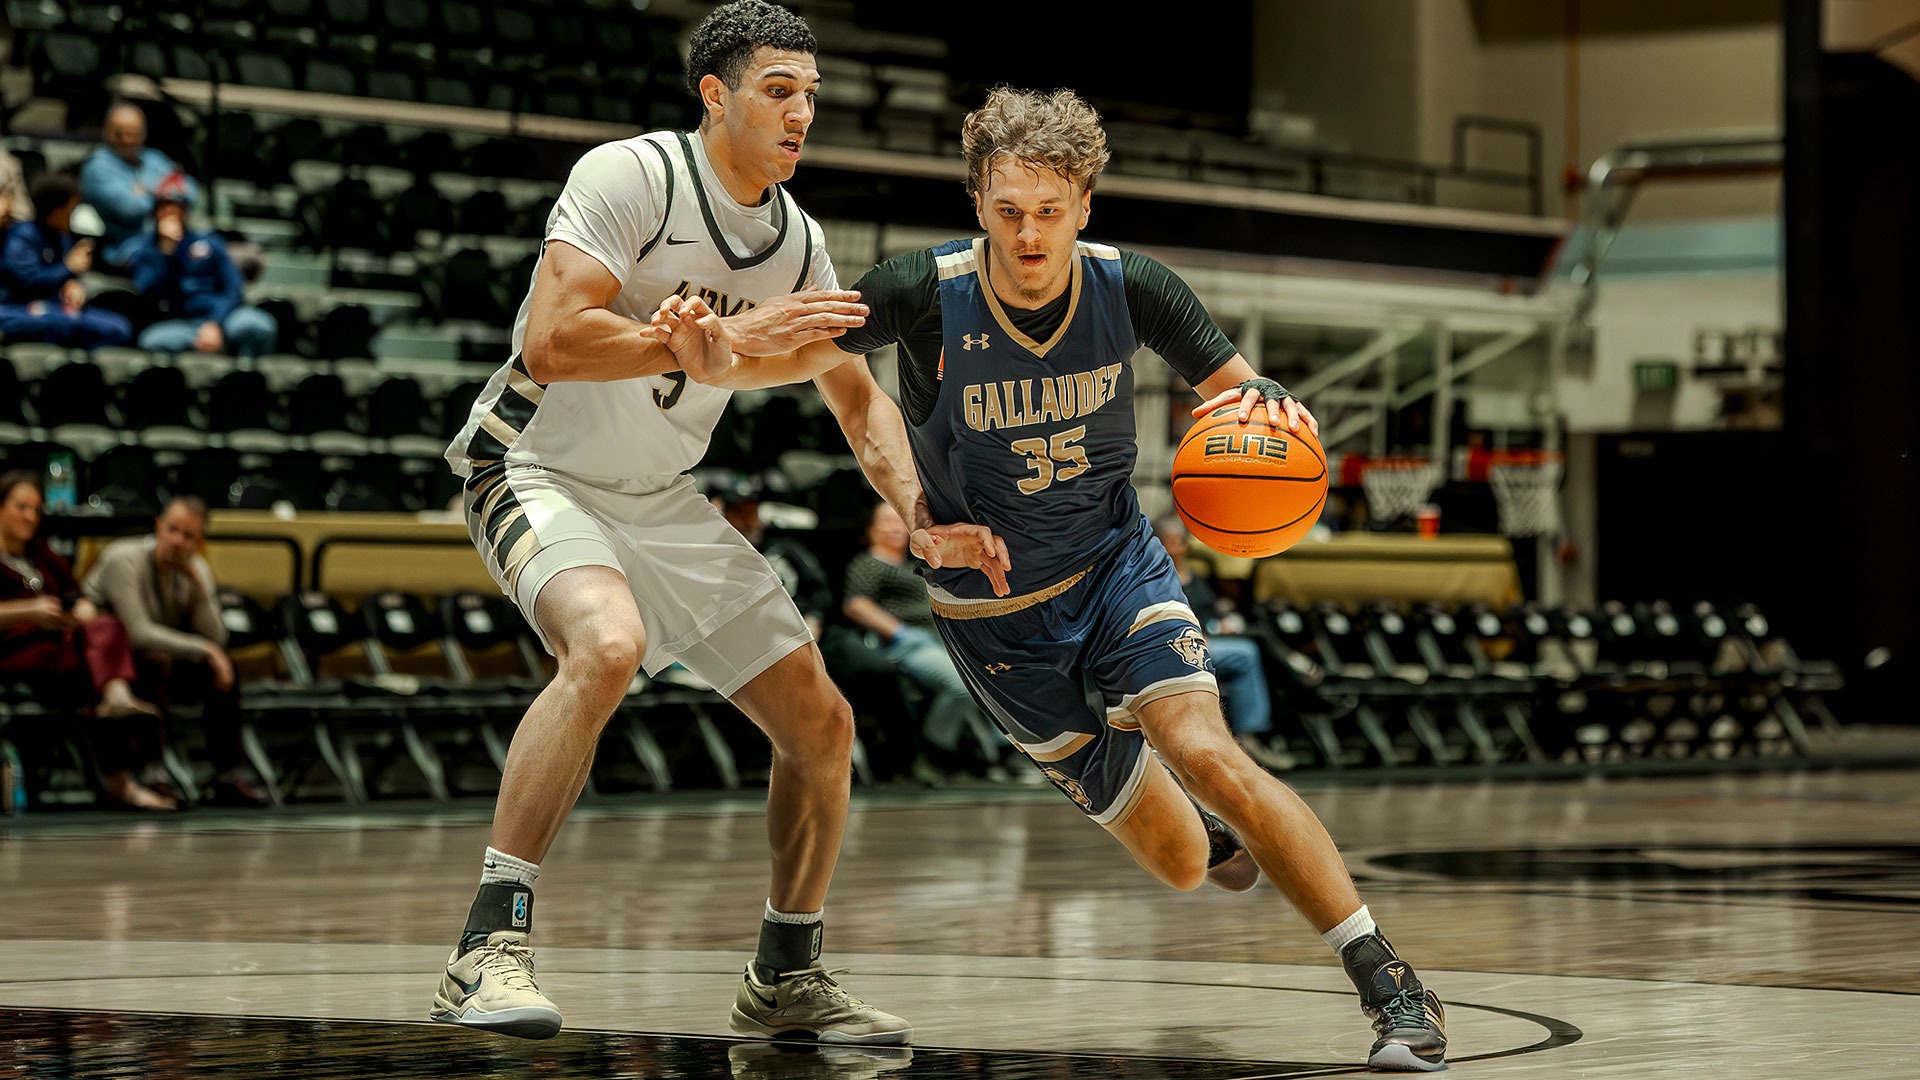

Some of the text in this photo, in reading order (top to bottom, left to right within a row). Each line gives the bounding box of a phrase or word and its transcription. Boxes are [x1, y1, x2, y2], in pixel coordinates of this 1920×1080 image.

[649, 279, 759, 319] ARM
[963, 362, 1122, 432] GALLAUDET
[1011, 424, 1091, 495] 35
[1204, 434, 1288, 460] ELITE
